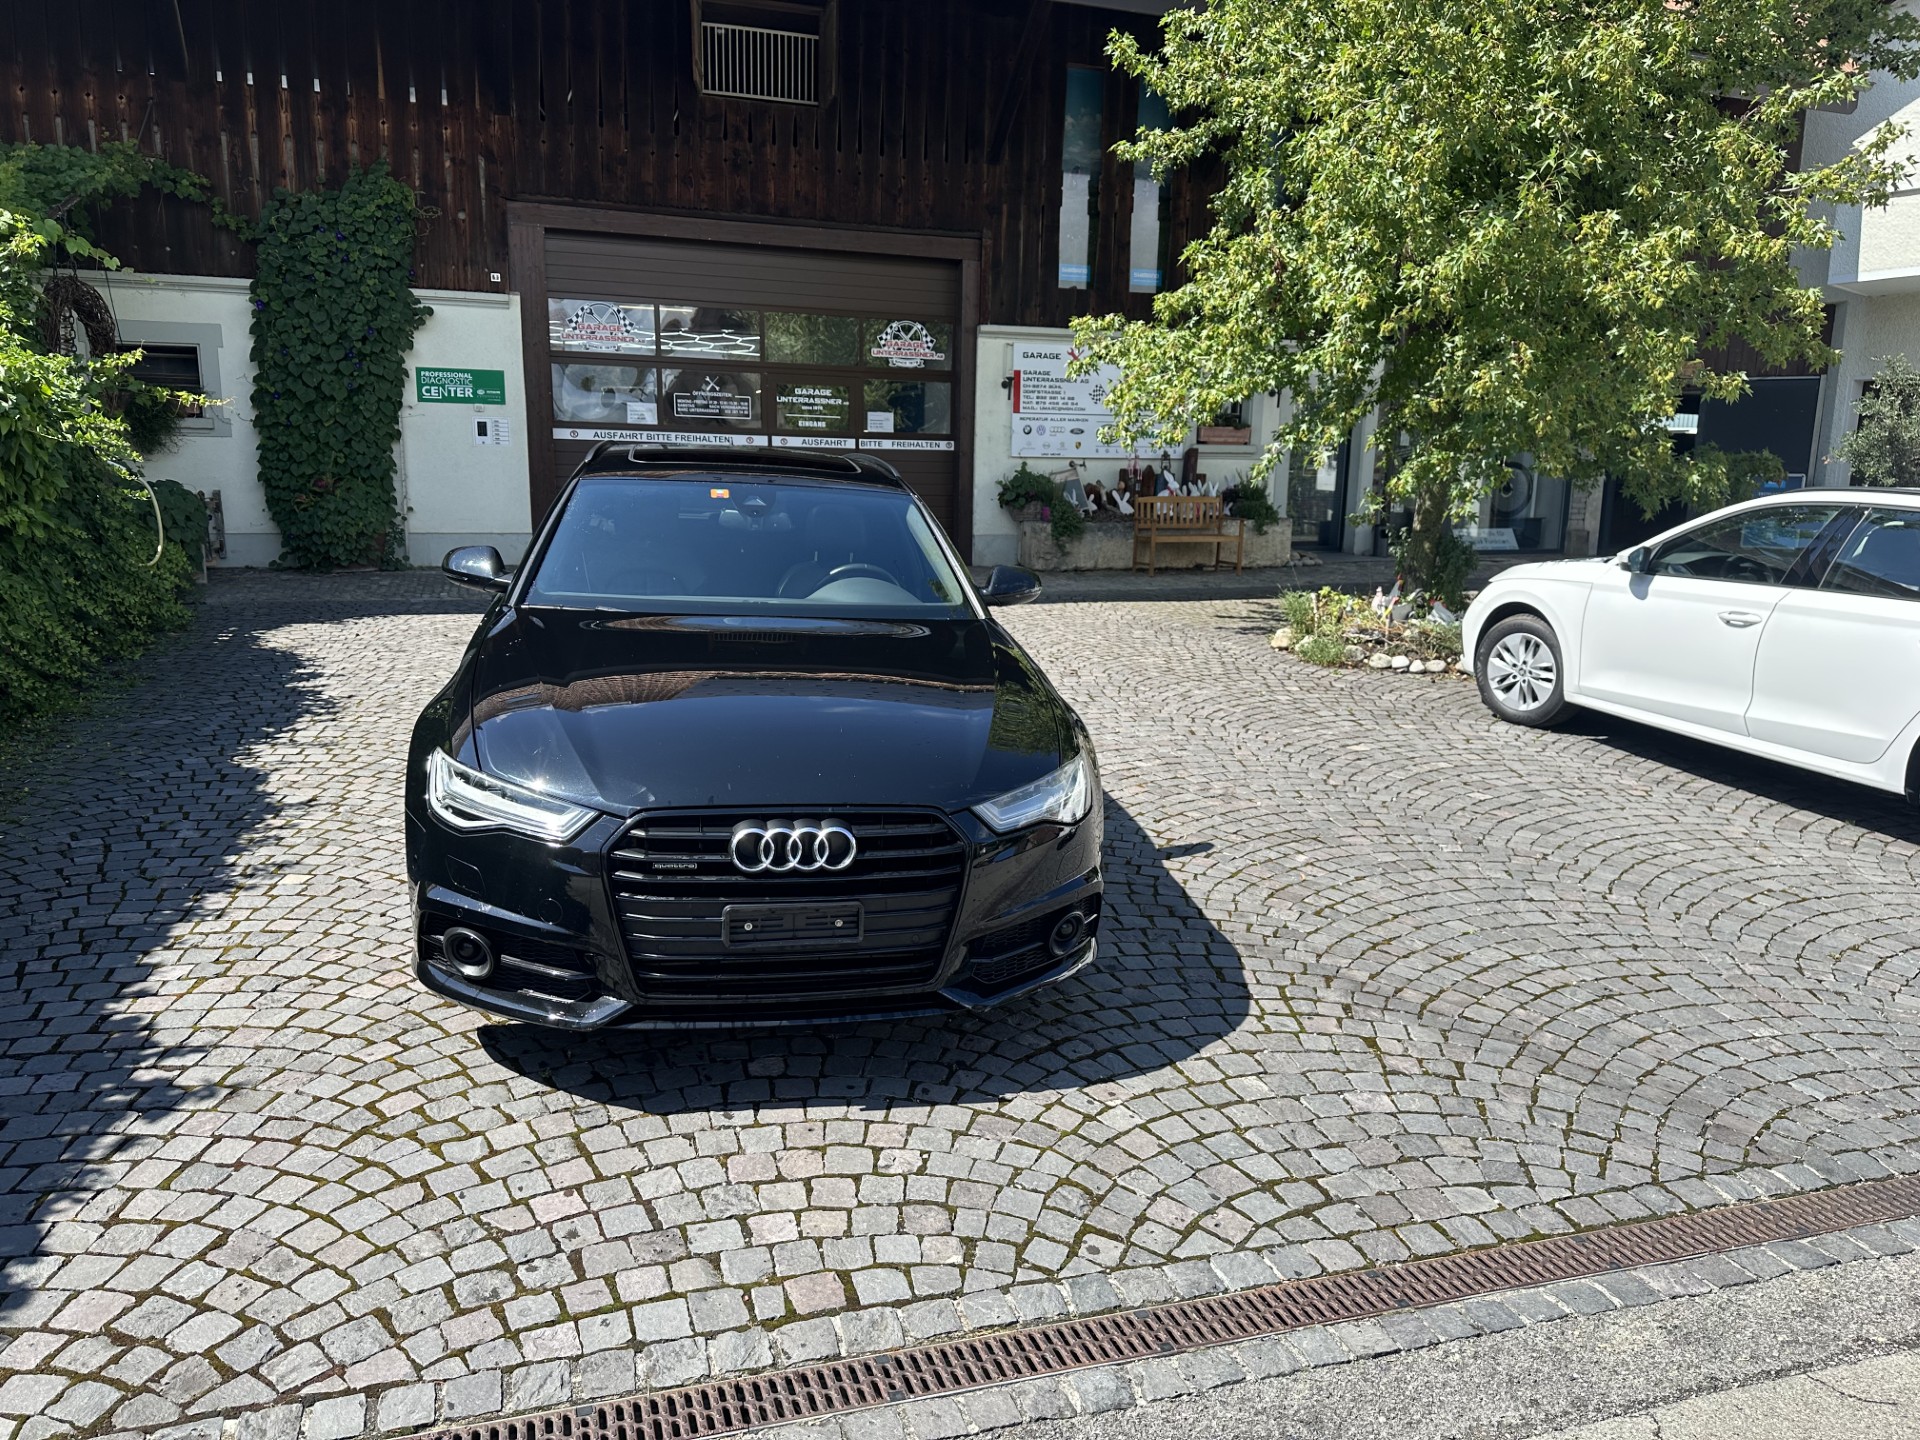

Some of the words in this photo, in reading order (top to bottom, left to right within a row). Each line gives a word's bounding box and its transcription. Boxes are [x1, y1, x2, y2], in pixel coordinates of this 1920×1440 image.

[561, 333, 635, 343] UNTERRASSNER
[873, 350, 935, 358] UNTERRASSNER
[422, 385, 473, 398] CENTER
[795, 388, 832, 396] GARAGE
[776, 396, 842, 404] UNTERRASSNER
[593, 432, 643, 440] AUSFAHRT
[675, 434, 730, 443] FREIHALTEN
